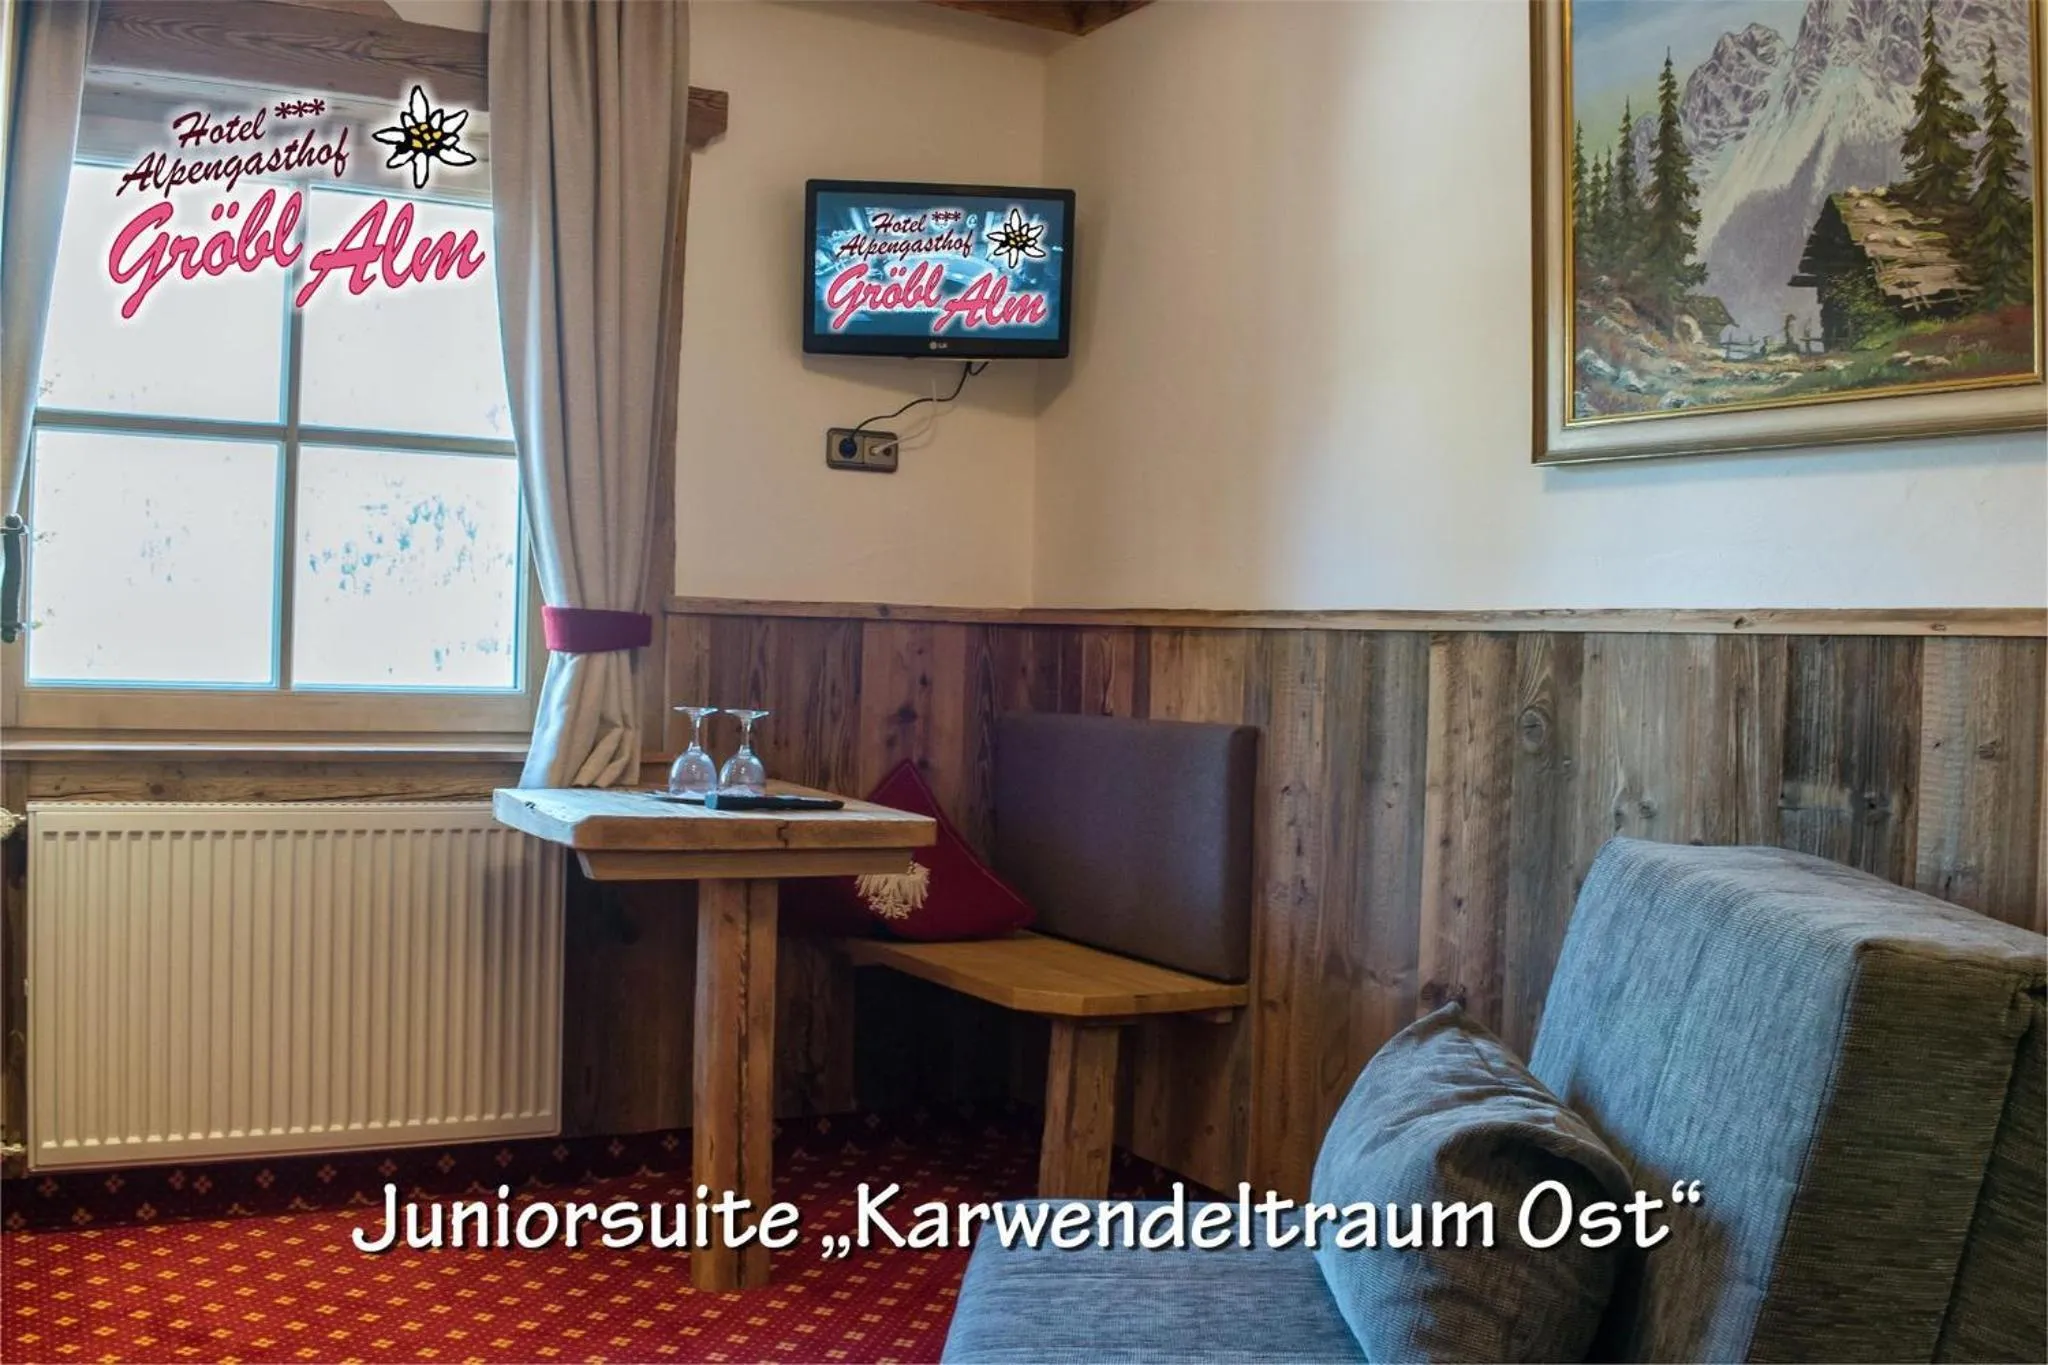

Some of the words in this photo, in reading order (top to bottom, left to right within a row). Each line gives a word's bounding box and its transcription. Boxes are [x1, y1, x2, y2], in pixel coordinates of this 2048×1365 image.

[871, 212, 928, 233] Hotel
[836, 229, 974, 261] Alpengasthof
[827, 260, 945, 330] Gröbl
[933, 272, 1047, 332] Alm
